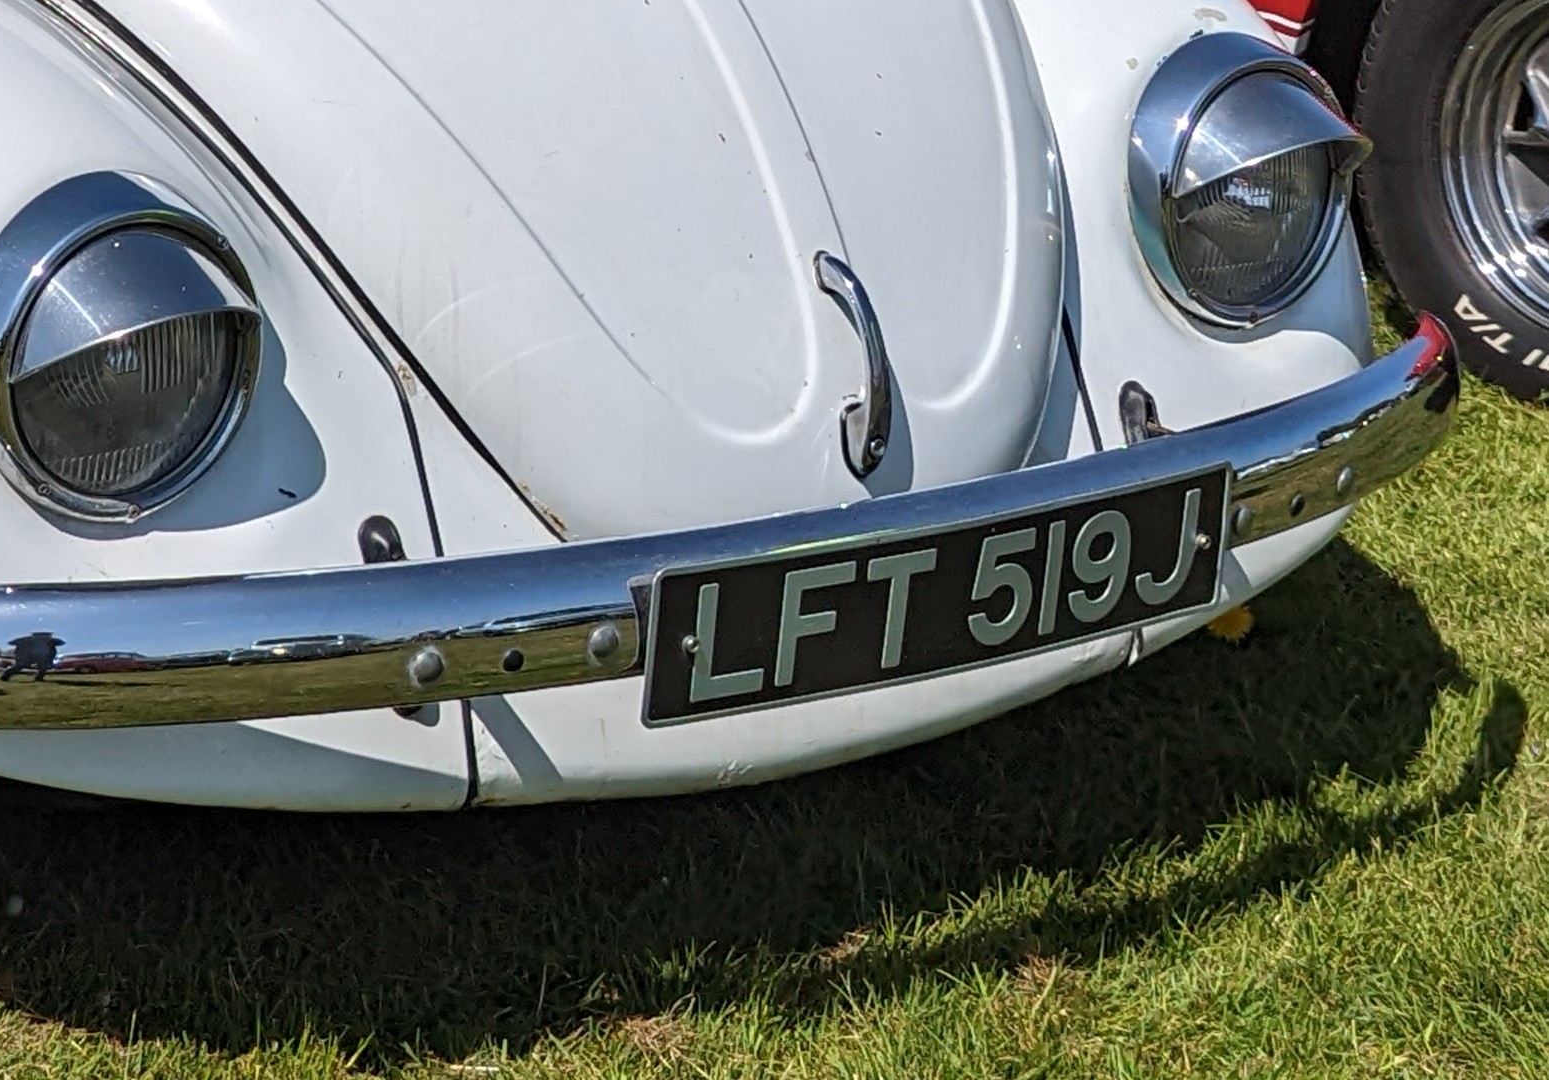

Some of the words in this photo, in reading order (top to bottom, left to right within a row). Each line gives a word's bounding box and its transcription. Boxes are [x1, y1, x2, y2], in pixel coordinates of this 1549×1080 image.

[1453, 293, 1514, 354] T/A
[690, 548, 938, 703] LFT
[967, 488, 1202, 646] 519J
